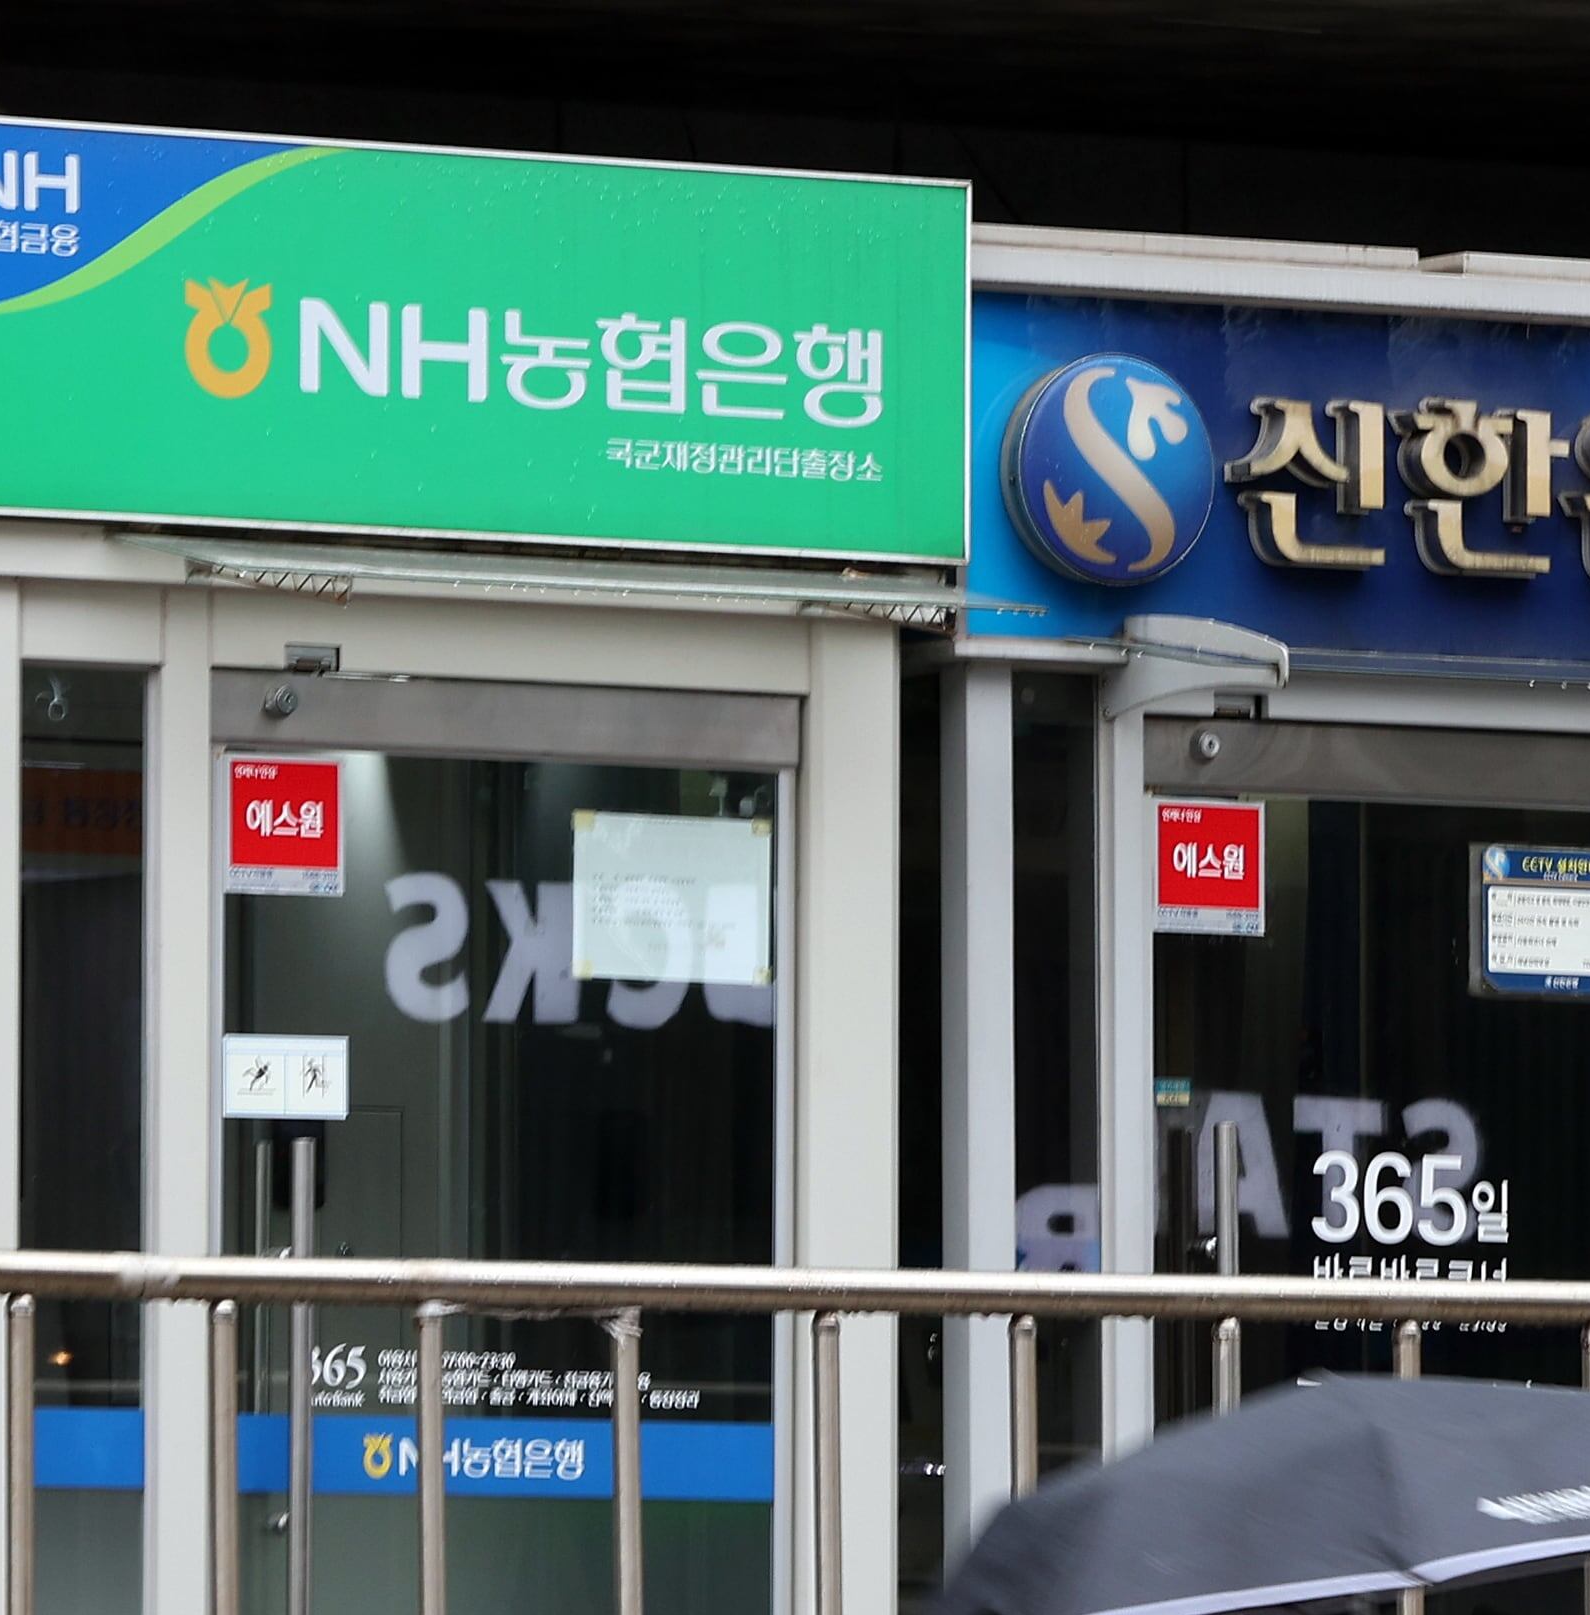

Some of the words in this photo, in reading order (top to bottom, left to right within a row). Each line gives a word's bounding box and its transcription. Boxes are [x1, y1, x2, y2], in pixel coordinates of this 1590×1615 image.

[299, 297, 883, 428] NH농협은행
[606, 437, 884, 482] 국군재정관리단출장소
[246, 799, 324, 838] 에스원
[1173, 842, 1245, 880] 에스원
[1311, 1150, 1509, 1247] 365일
[377, 1349, 418, 1368] 이용시
